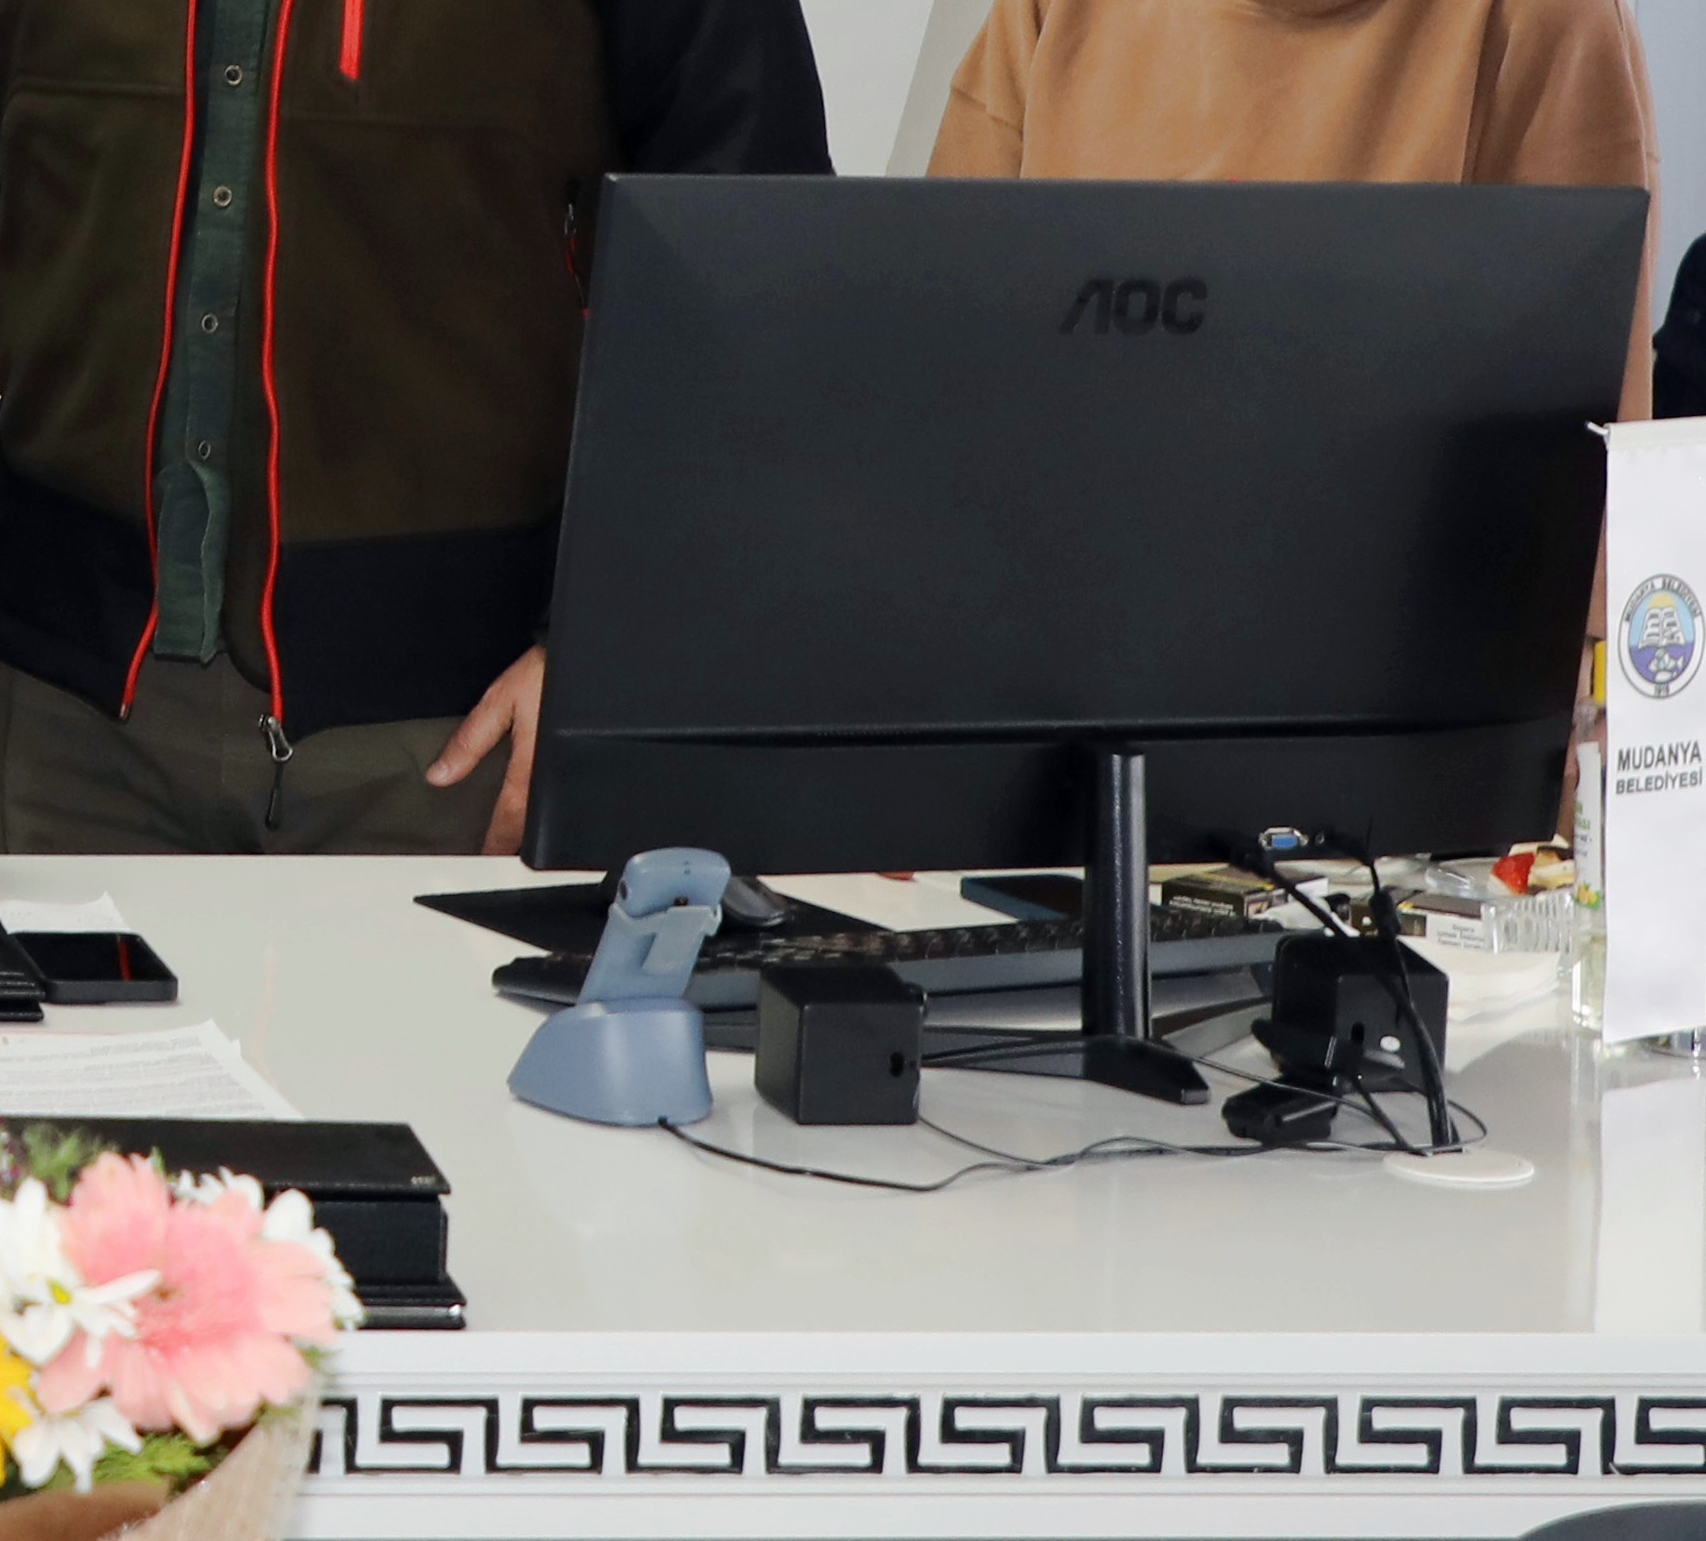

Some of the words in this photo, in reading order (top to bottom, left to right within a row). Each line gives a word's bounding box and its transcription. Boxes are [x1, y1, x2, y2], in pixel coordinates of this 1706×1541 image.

[1058, 278, 1208, 335] AOC
[1617, 740, 1702, 773] MUDANYA
[1615, 765, 1703, 795] BELEDİYESİ
